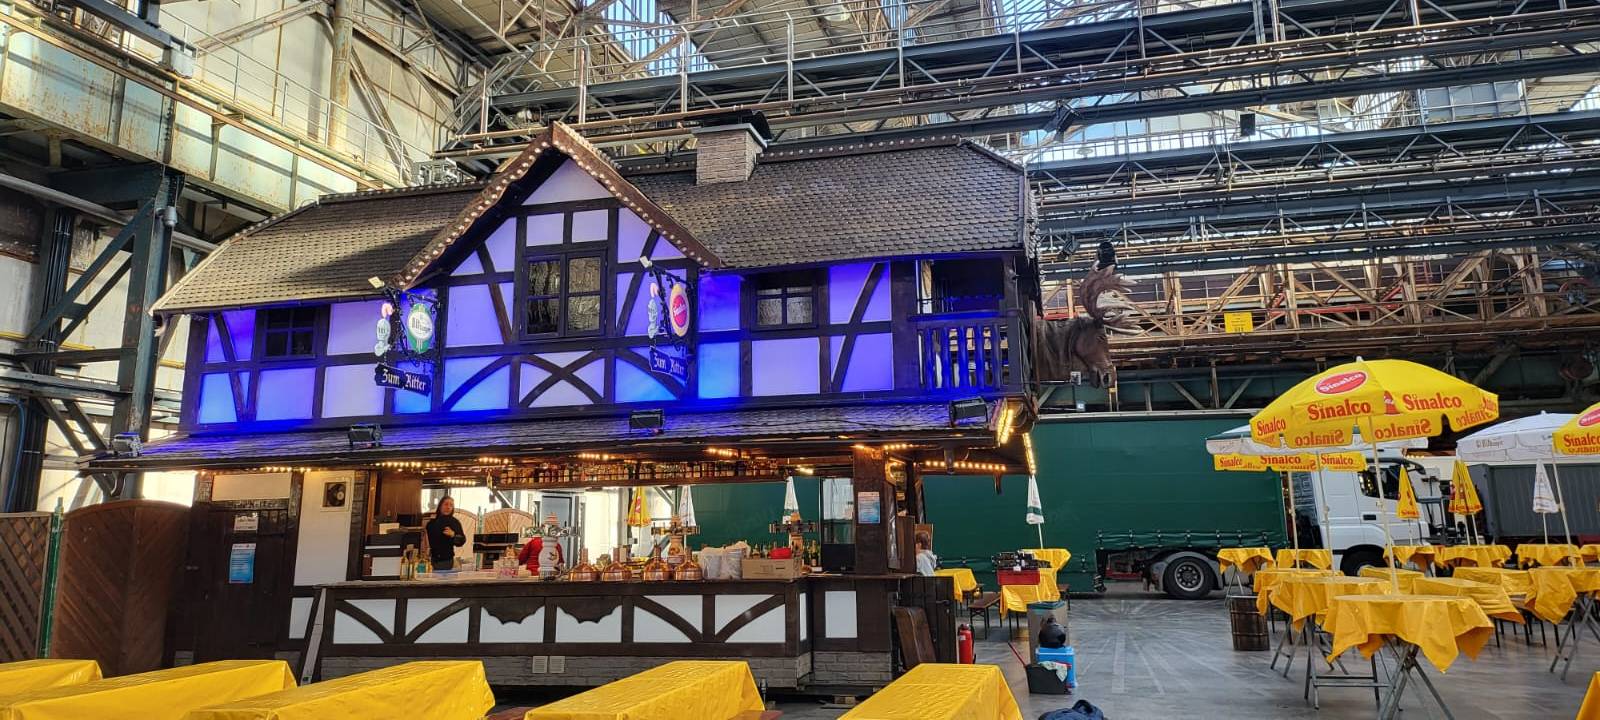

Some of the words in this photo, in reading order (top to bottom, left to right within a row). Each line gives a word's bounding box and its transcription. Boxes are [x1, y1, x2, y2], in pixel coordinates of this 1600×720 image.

[381, 368, 400, 386] Zum
[405, 373, 427, 391] Ritter
[1319, 373, 1363, 391] Sinalco
[1308, 398, 1371, 420] Sinalco
[1402, 392, 1462, 411] Sinalco
[1257, 416, 1286, 436] Sinalco
[1260, 455, 1301, 464] Sinalco
[1321, 453, 1353, 465] Sinalco
